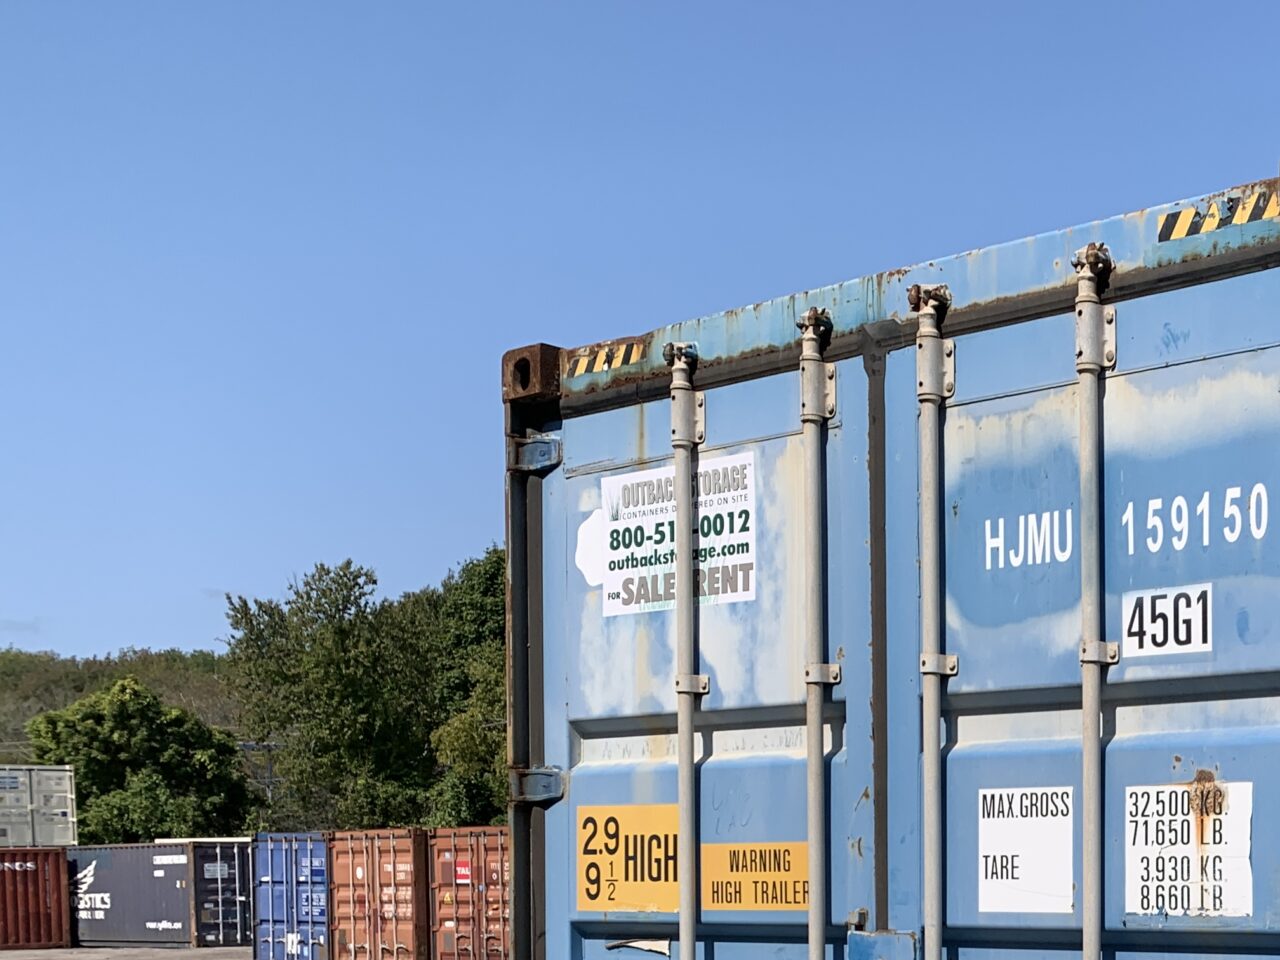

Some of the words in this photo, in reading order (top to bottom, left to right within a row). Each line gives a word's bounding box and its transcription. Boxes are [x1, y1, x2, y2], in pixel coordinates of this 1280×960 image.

[622, 506, 669, 520] CONTAINERS
[716, 497, 729, 506] ON
[731, 493, 749, 504] SITE
[609, 509, 750, 551] 800-51-0012
[985, 508, 1073, 570] HJMU
[1122, 482, 1269, 556] 159150
[608, 541, 750, 572] outbackstage.com
[607, 591, 621, 601] FOR
[621, 572, 676, 606] SALE
[692, 562, 754, 598] RENT
[1127, 589, 1209, 649] 45G1
[982, 791, 1070, 819] MAX.GROSS
[1129, 790, 1191, 818] 32,500
[582, 816, 620, 856] 2.9
[1129, 819, 1191, 846] 71,650
[1200, 818, 1228, 845] LB.
[456, 867, 470, 875] TAL
[624, 834, 678, 882] HIGH
[729, 849, 791, 873] WARNING
[983, 855, 1020, 880] TARE
[1140, 855, 1191, 883] 3,930
[711, 880, 742, 905] HIGH
[752, 880, 810, 904] TRAILER
[1140, 884, 1191, 912] 8,660
